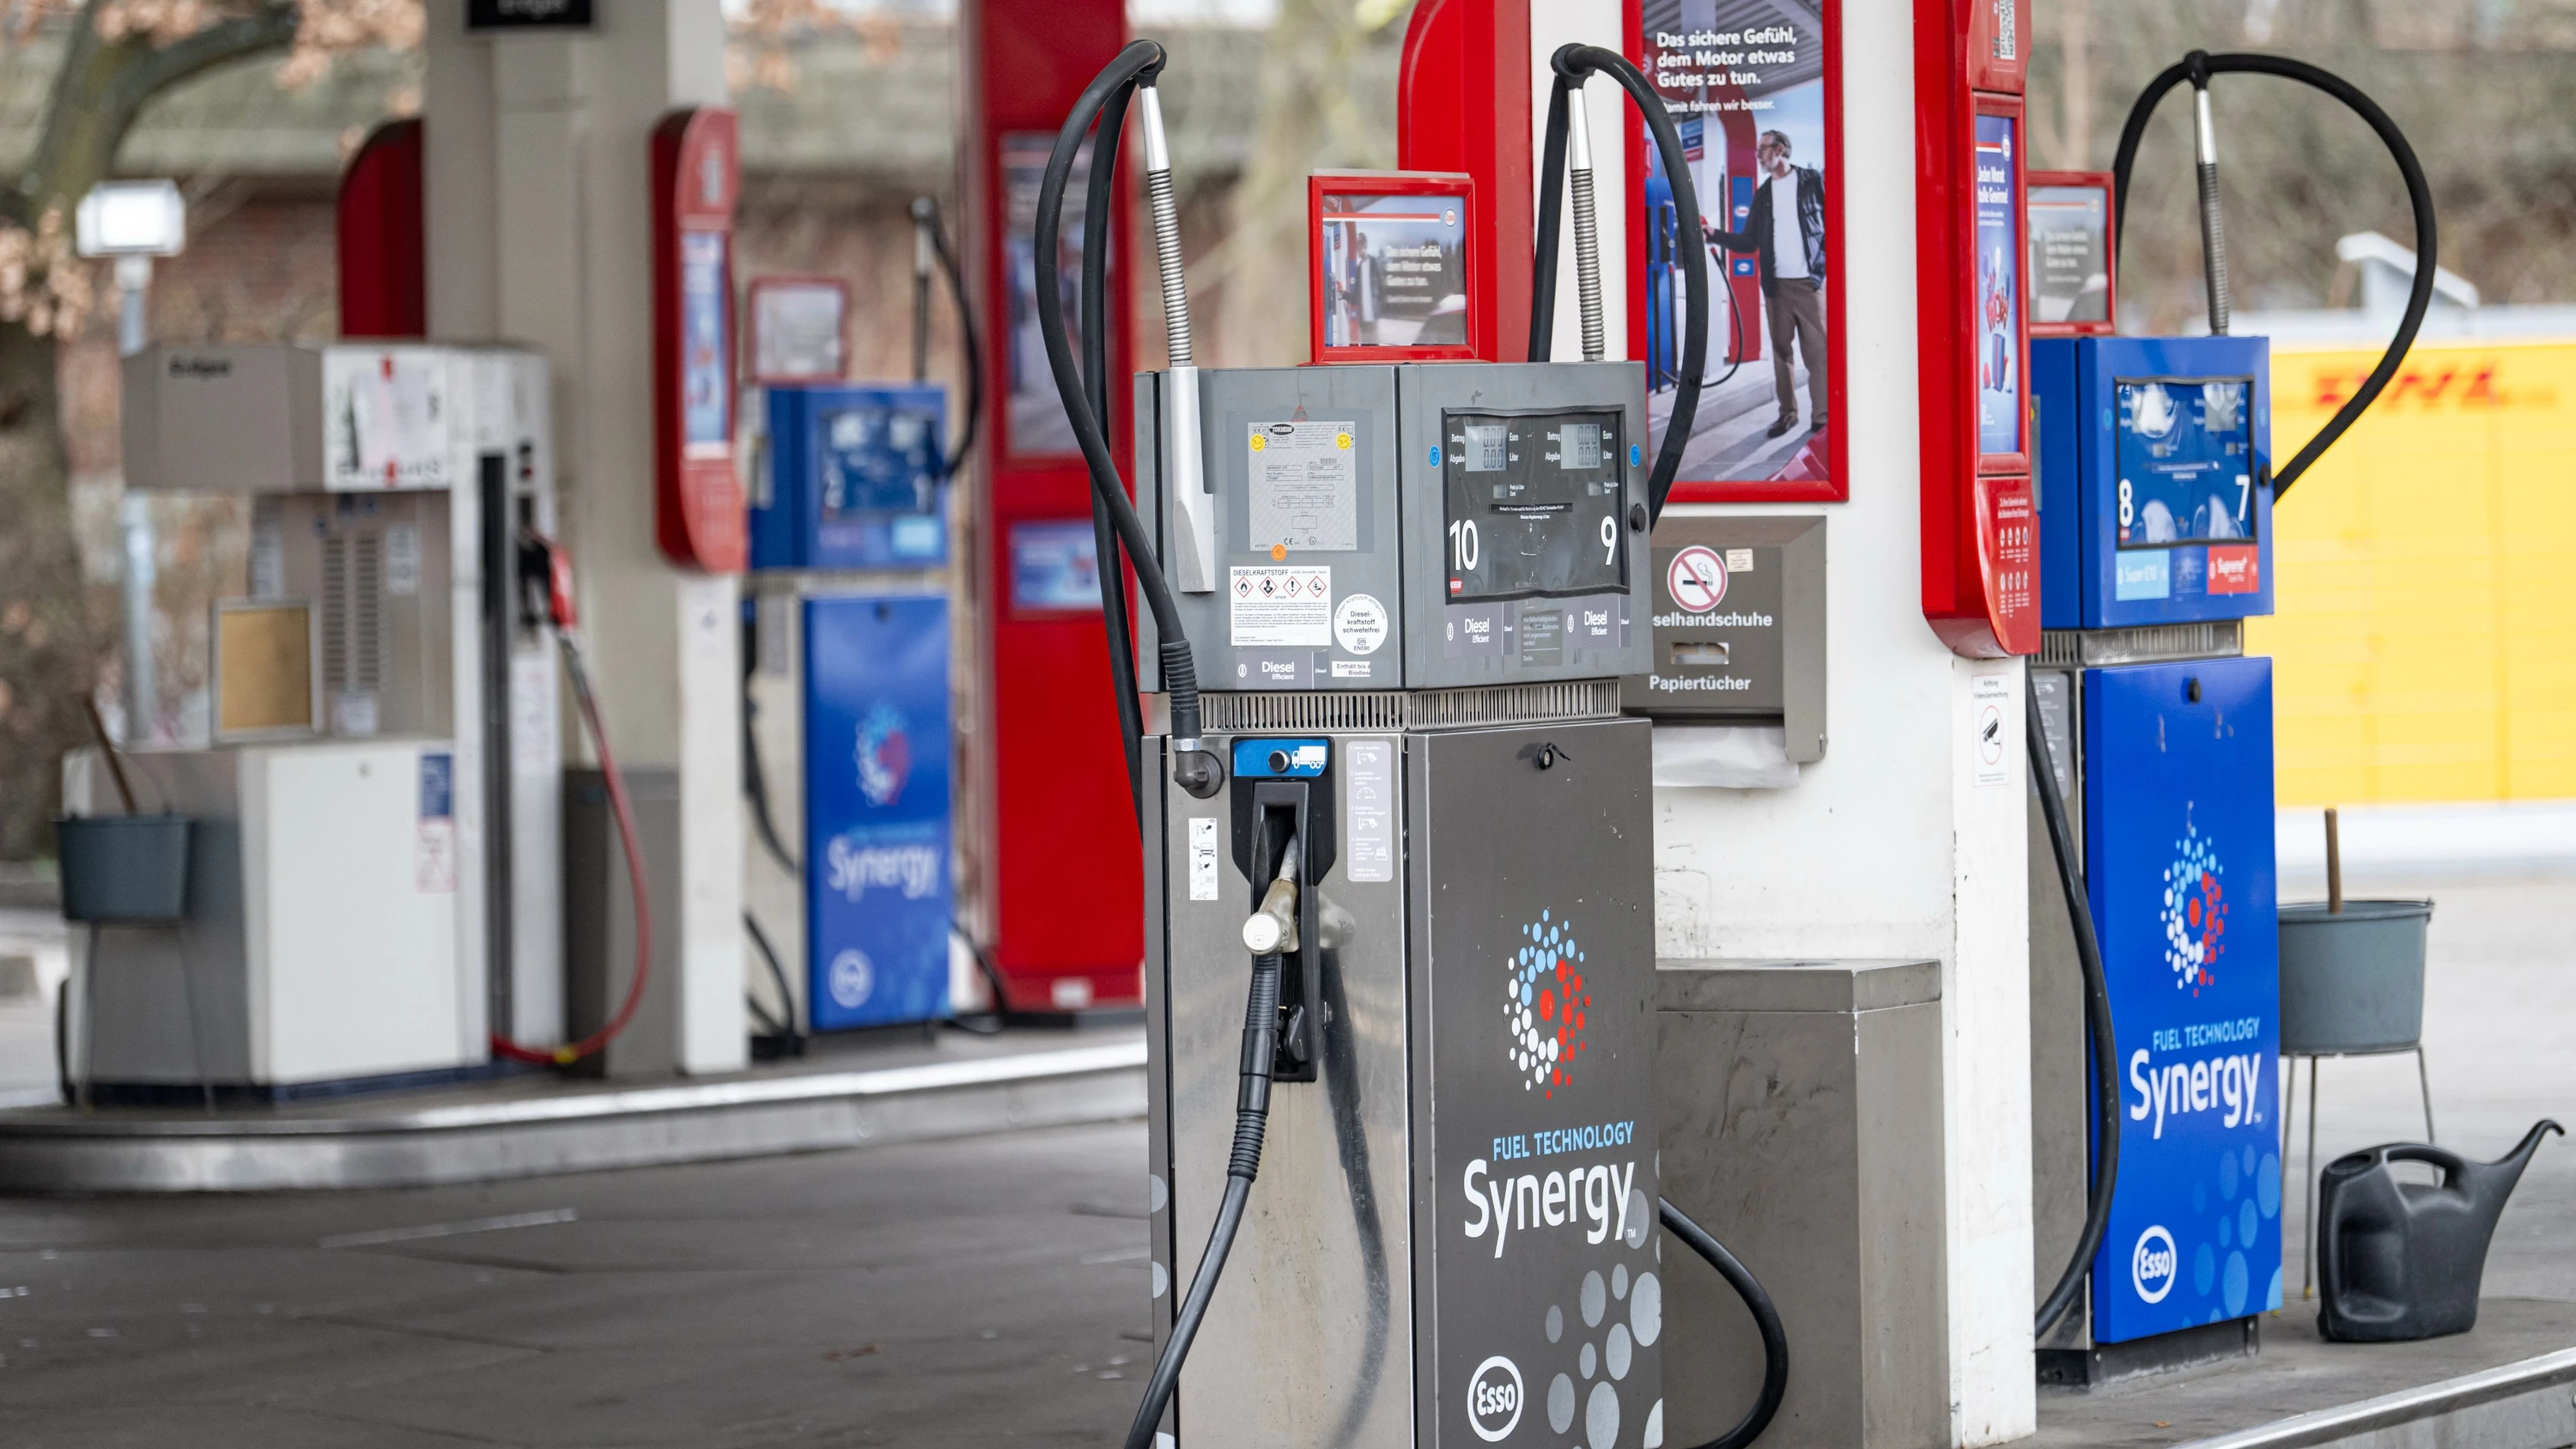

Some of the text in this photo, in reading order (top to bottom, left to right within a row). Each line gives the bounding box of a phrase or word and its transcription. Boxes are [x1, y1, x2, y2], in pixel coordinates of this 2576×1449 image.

[1656, 26, 1797, 48] Das sichere Gefühl,
[1656, 49, 1795, 68] dem Motor etwas
[1657, 70, 1761, 88] Gutes zu tun.
[1663, 98, 1775, 113] amit fahren wir besser.
[1451, 434, 1465, 444] Betrag
[1509, 432, 1519, 441] Euro
[1546, 431, 1560, 442] Betrag
[1602, 430, 1613, 440] Euro
[1449, 454, 1465, 465] Abgabe
[1509, 453, 1519, 461] Liter
[1545, 452, 1560, 462] Abgabe
[1603, 451, 1613, 460] Liter
[2118, 478, 2134, 527] 8
[2235, 474, 2250, 522] 7
[1449, 519, 1479, 571] 10
[1601, 515, 1617, 565] 9
[1464, 618, 1490, 634] Diesel
[1584, 610, 1607, 626] Diesel
[1652, 612, 1773, 627] selhandschuhe
[1473, 634, 1490, 643] Efficient
[1591, 627, 1607, 636] Efficient
[1261, 661, 1295, 673] Diesel
[1649, 674, 1752, 693] Papiertücher
[828, 832, 938, 904] Synergy
[2153, 1016, 2261, 1053] FUEL TECHNOLOGY
[2129, 1048, 2262, 1140] Synergy
[1493, 1120, 1634, 1161] FUEL TECHNOLOGY
[1463, 1159, 1635, 1259] Synergy
[2139, 1246, 2171, 1281] Esso
[1476, 1380, 1516, 1416] Esso
